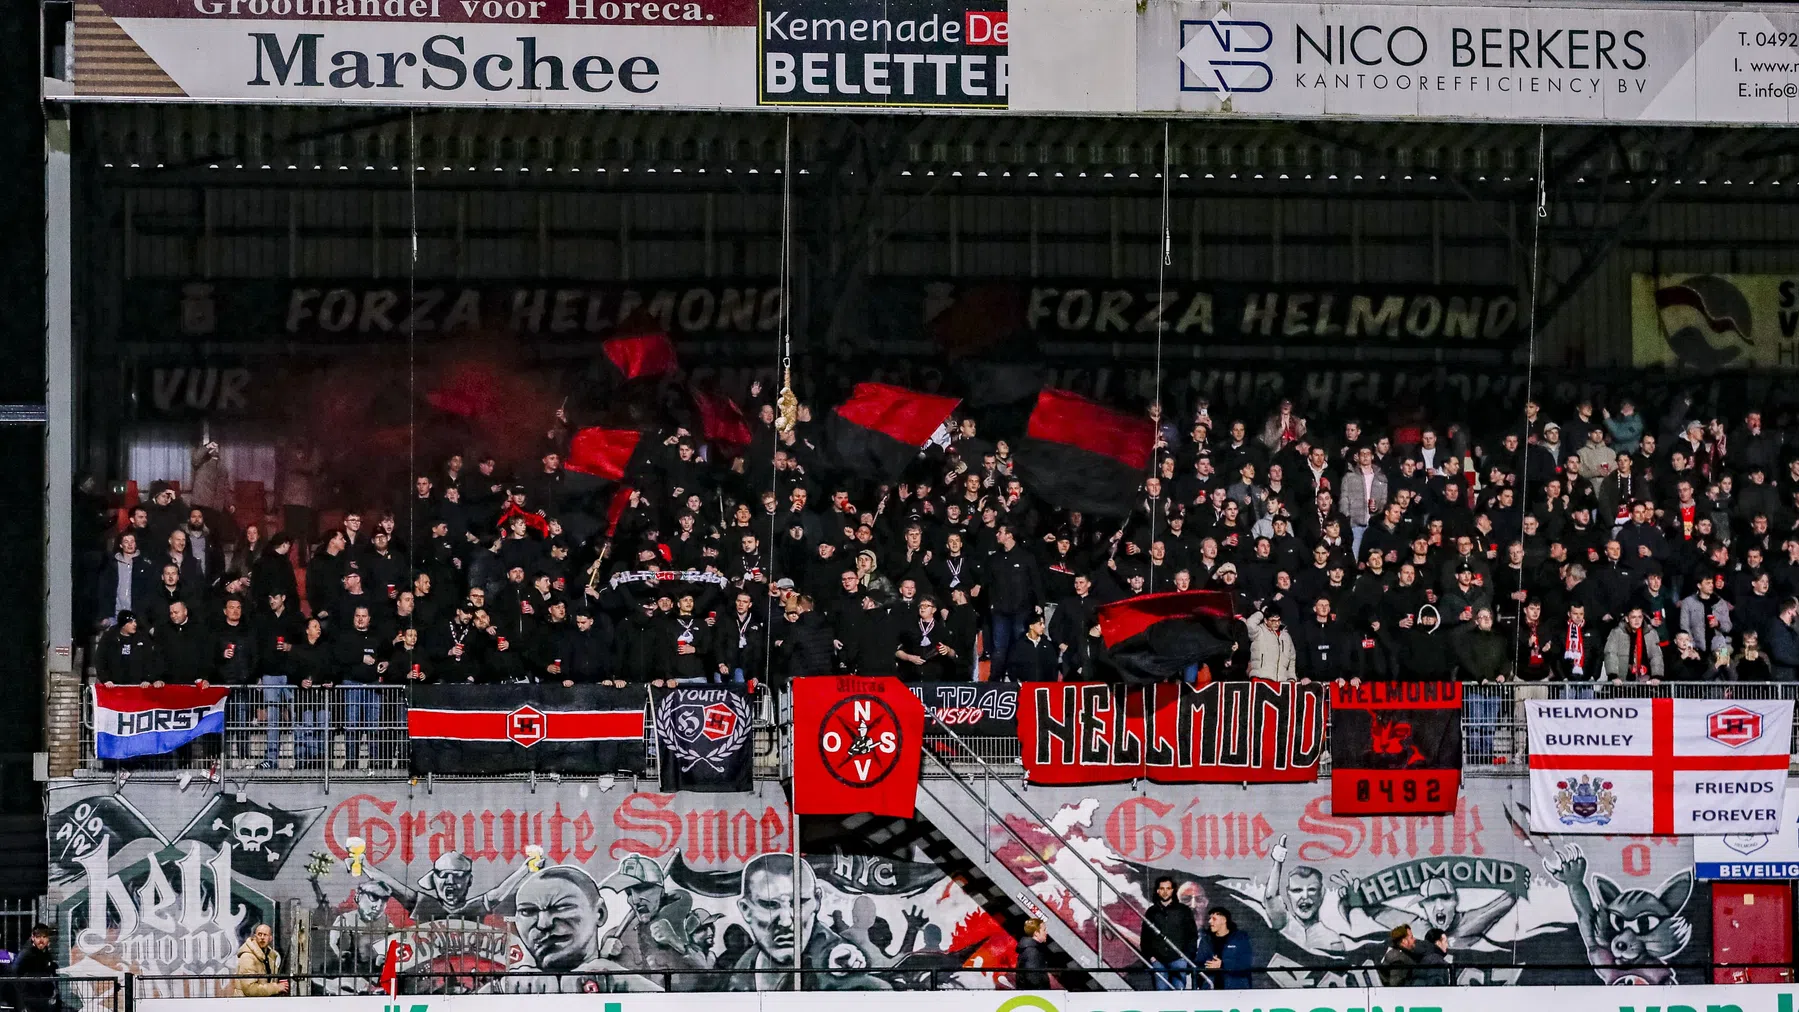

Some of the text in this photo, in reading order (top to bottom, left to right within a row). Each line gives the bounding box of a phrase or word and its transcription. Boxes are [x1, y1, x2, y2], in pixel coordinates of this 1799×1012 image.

[459, 1, 546, 19] voor
[565, 0, 714, 21] Horeca.
[766, 11, 960, 43] Kemenade
[1297, 24, 1647, 71] NICO BERKERS
[1738, 32, 1798, 47] T. 0492
[247, 32, 660, 94] MarSchee
[1296, 73, 1647, 94] KANTOOREFFICIENCY BV
[1739, 83, 1798, 98] E. info@
[286, 286, 787, 334] FORZA HELMOND
[1027, 287, 1517, 340] FORZA HELMOND
[152, 367, 251, 409] VUR
[678, 689, 728, 702] YOUTH
[1339, 680, 1456, 703] HELMOND
[117, 707, 211, 735] HORST
[1538, 707, 1639, 719] HELMOND
[1035, 681, 1325, 770] HELLMOND
[1546, 734, 1634, 747] BURNLEY
[1357, 779, 1440, 803] 0492
[1695, 782, 1774, 794] FRIENDS
[1692, 809, 1777, 821] FOREVER
[1361, 860, 1517, 904] HELLMOND
